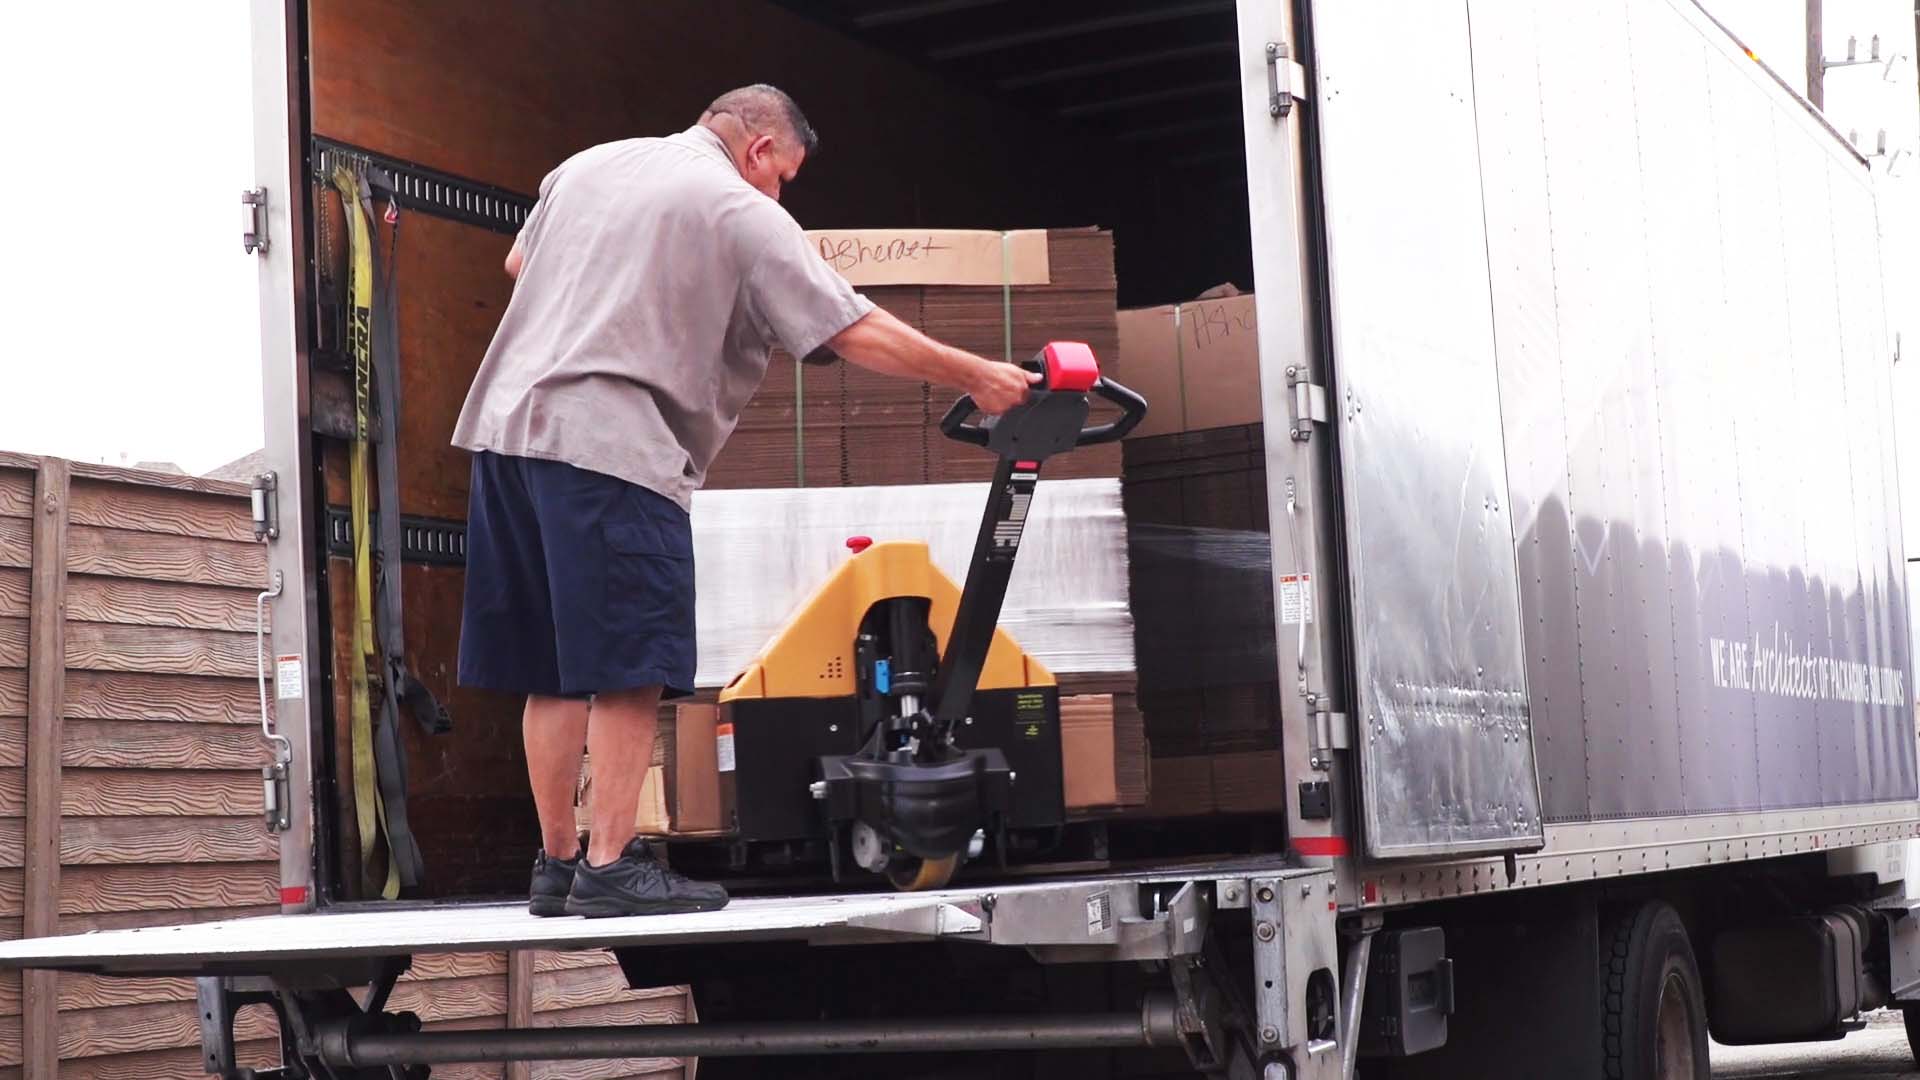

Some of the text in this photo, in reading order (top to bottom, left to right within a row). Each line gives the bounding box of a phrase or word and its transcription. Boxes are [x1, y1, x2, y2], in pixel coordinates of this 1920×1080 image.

[1710, 638, 1728, 688] WE
[1729, 641, 1750, 690] ARE
[1751, 619, 1818, 700] Architects
[1818, 656, 1829, 699] OF
